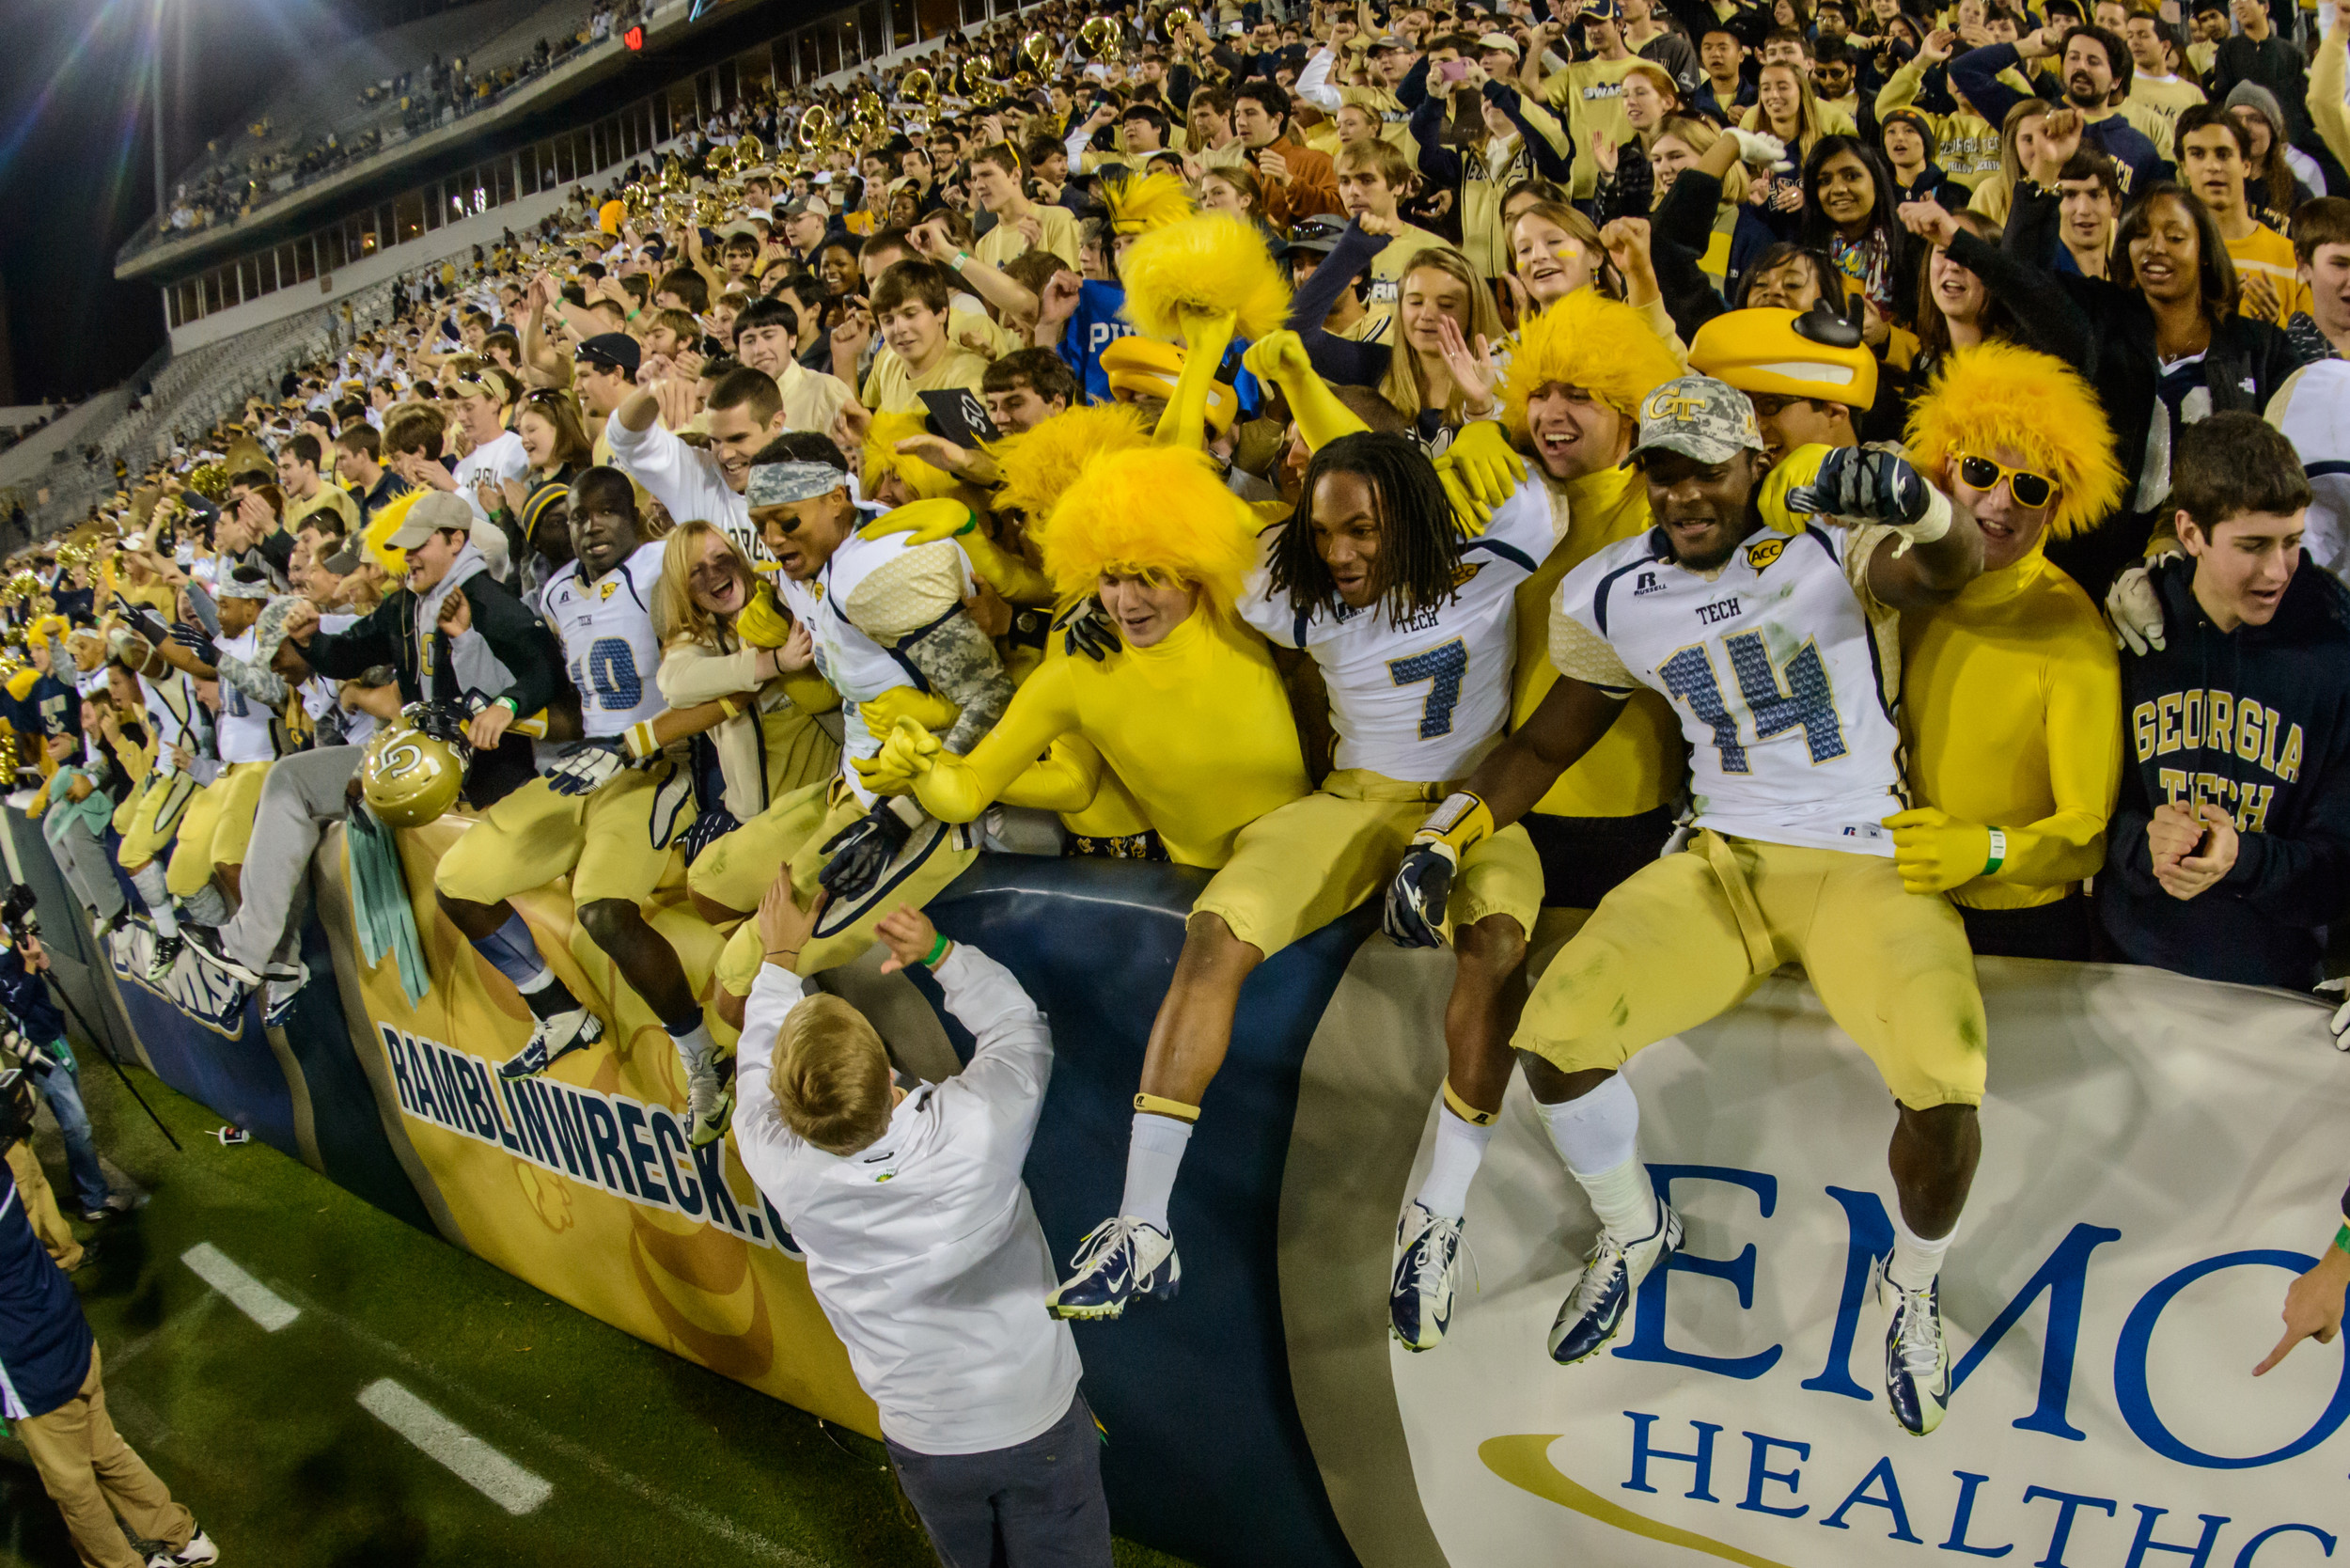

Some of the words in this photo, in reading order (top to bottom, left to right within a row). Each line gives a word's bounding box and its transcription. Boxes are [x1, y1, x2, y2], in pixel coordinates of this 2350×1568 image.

[1749, 544, 1779, 564] ACC
[1634, 583, 1668, 597] RUSSELL
[1695, 597, 1743, 626] TECH
[1398, 611, 1440, 634] TECH
[1385, 635, 1471, 742] 7
[1654, 625, 1852, 776] 14
[2133, 688, 2303, 783] GEORGIA
[2159, 767, 2275, 833] TECH
